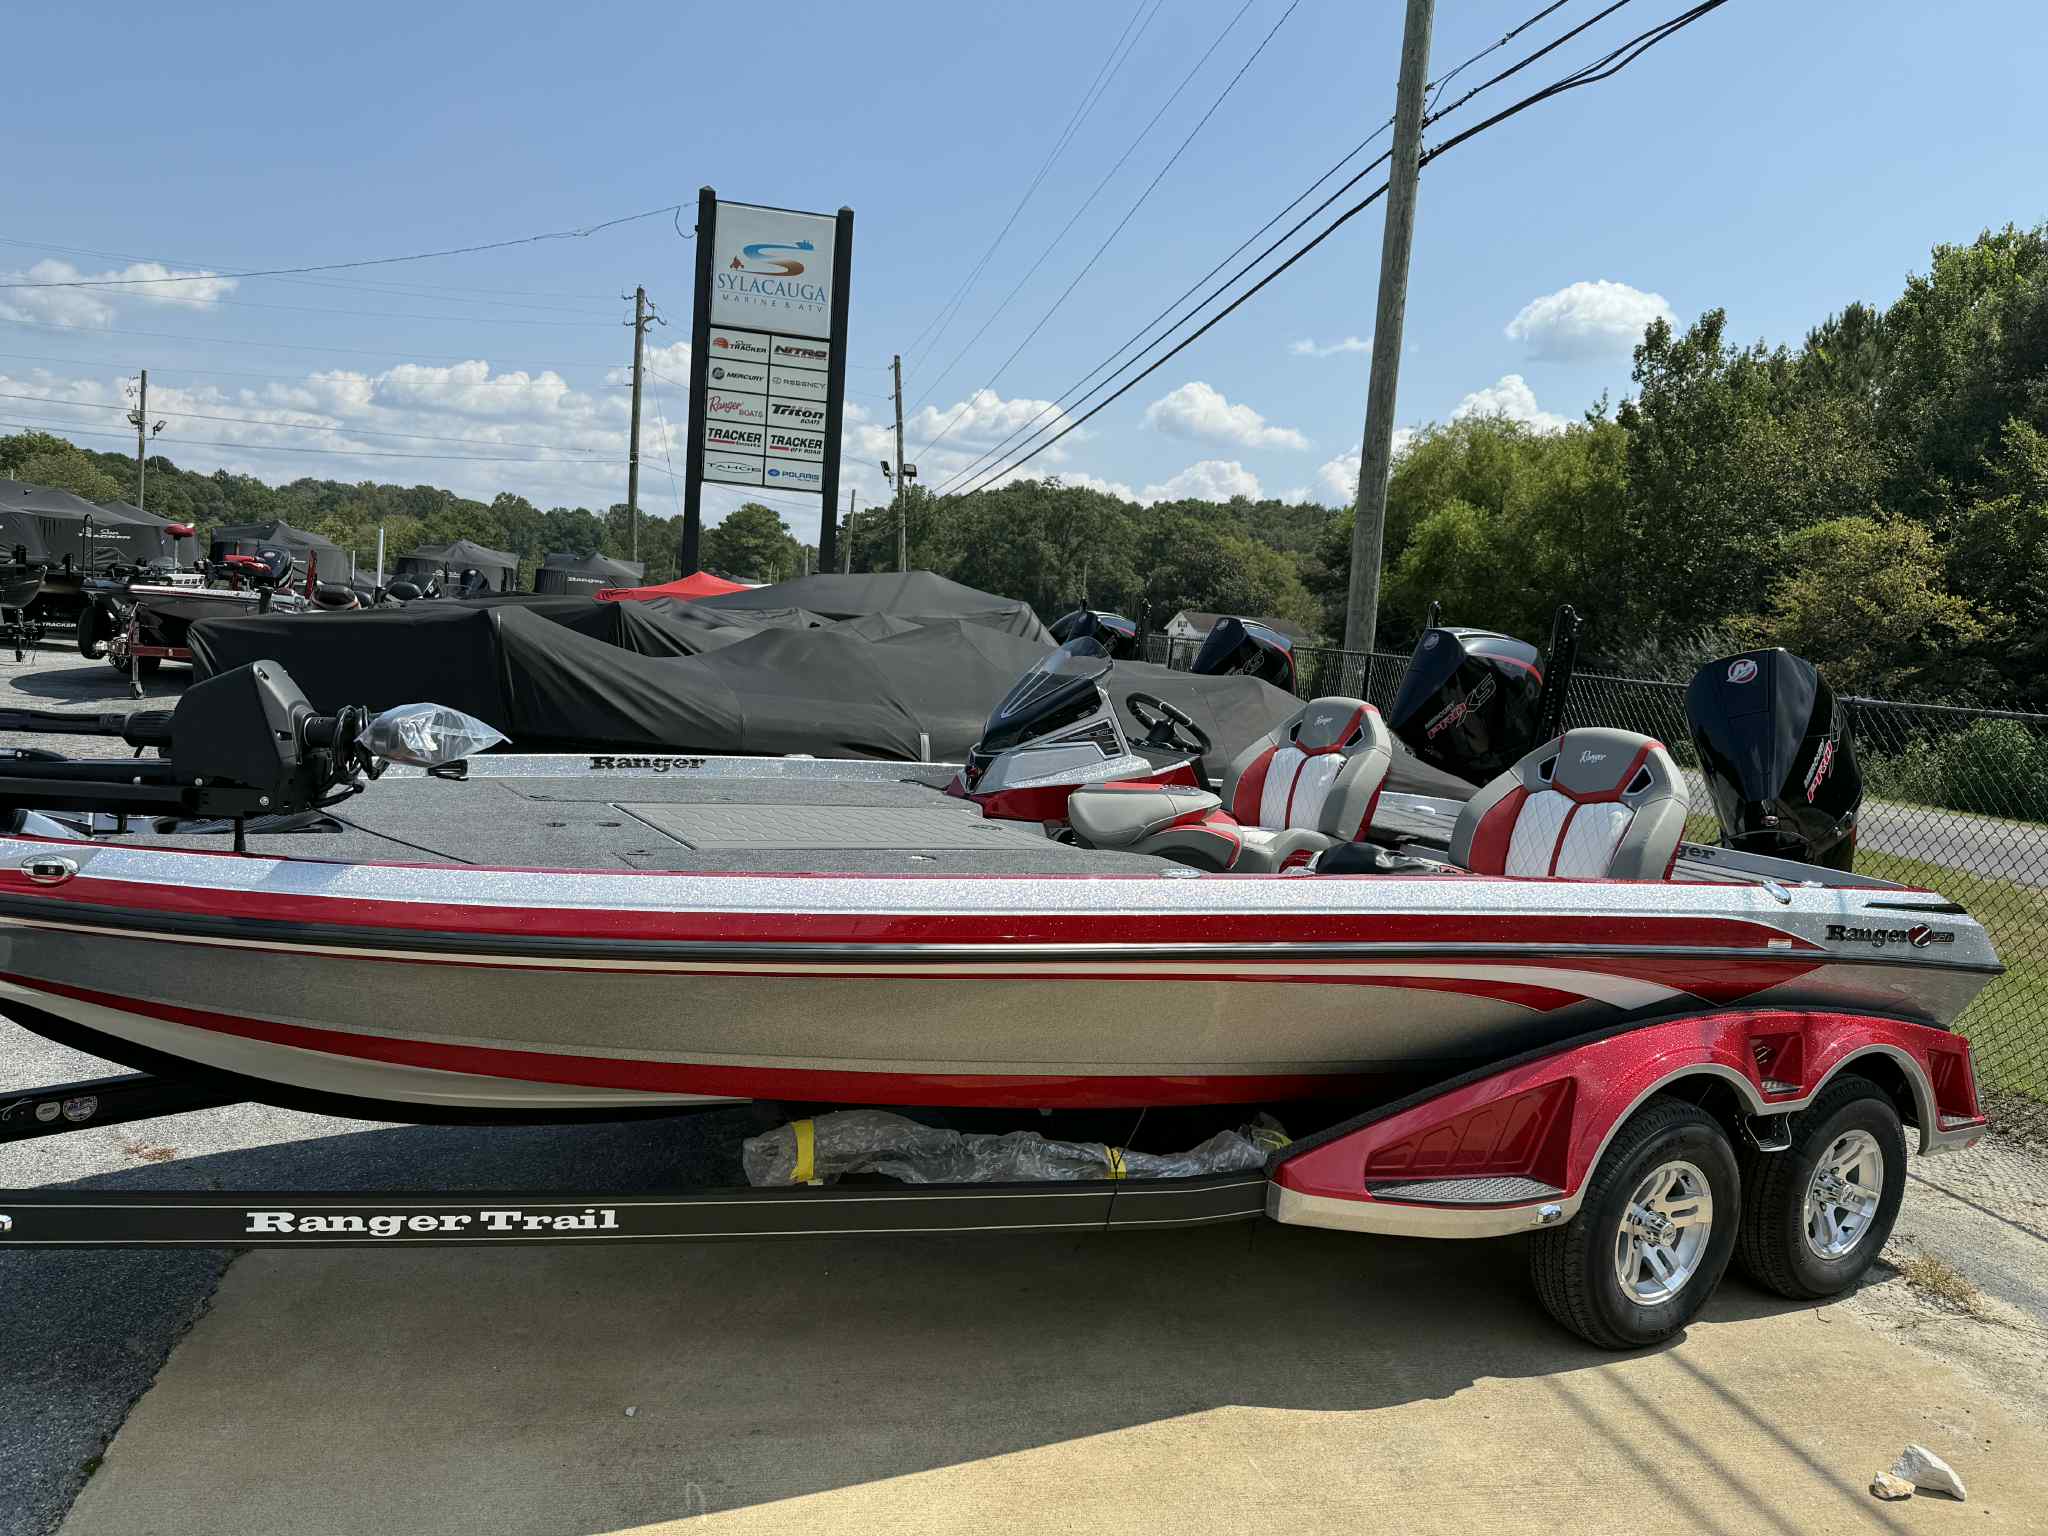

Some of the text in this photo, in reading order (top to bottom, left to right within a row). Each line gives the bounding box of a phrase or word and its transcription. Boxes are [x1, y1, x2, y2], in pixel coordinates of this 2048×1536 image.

[717, 273, 826, 303] SYLACAUGA
[722, 293, 776, 307] MARINE
[798, 304, 823, 313] ATV
[729, 343, 767, 353] TRACKER
[774, 344, 827, 358] NITRO
[726, 371, 764, 382] MERCURY
[709, 395, 742, 413] Ranger
[771, 403, 824, 419] Triton
[708, 427, 762, 444] TRACKER
[770, 434, 823, 450] TRACKER
[590, 756, 706, 773] Ranger
[1825, 924, 1909, 948] Ranger
[246, 1209, 619, 1237] Ranger Trail
